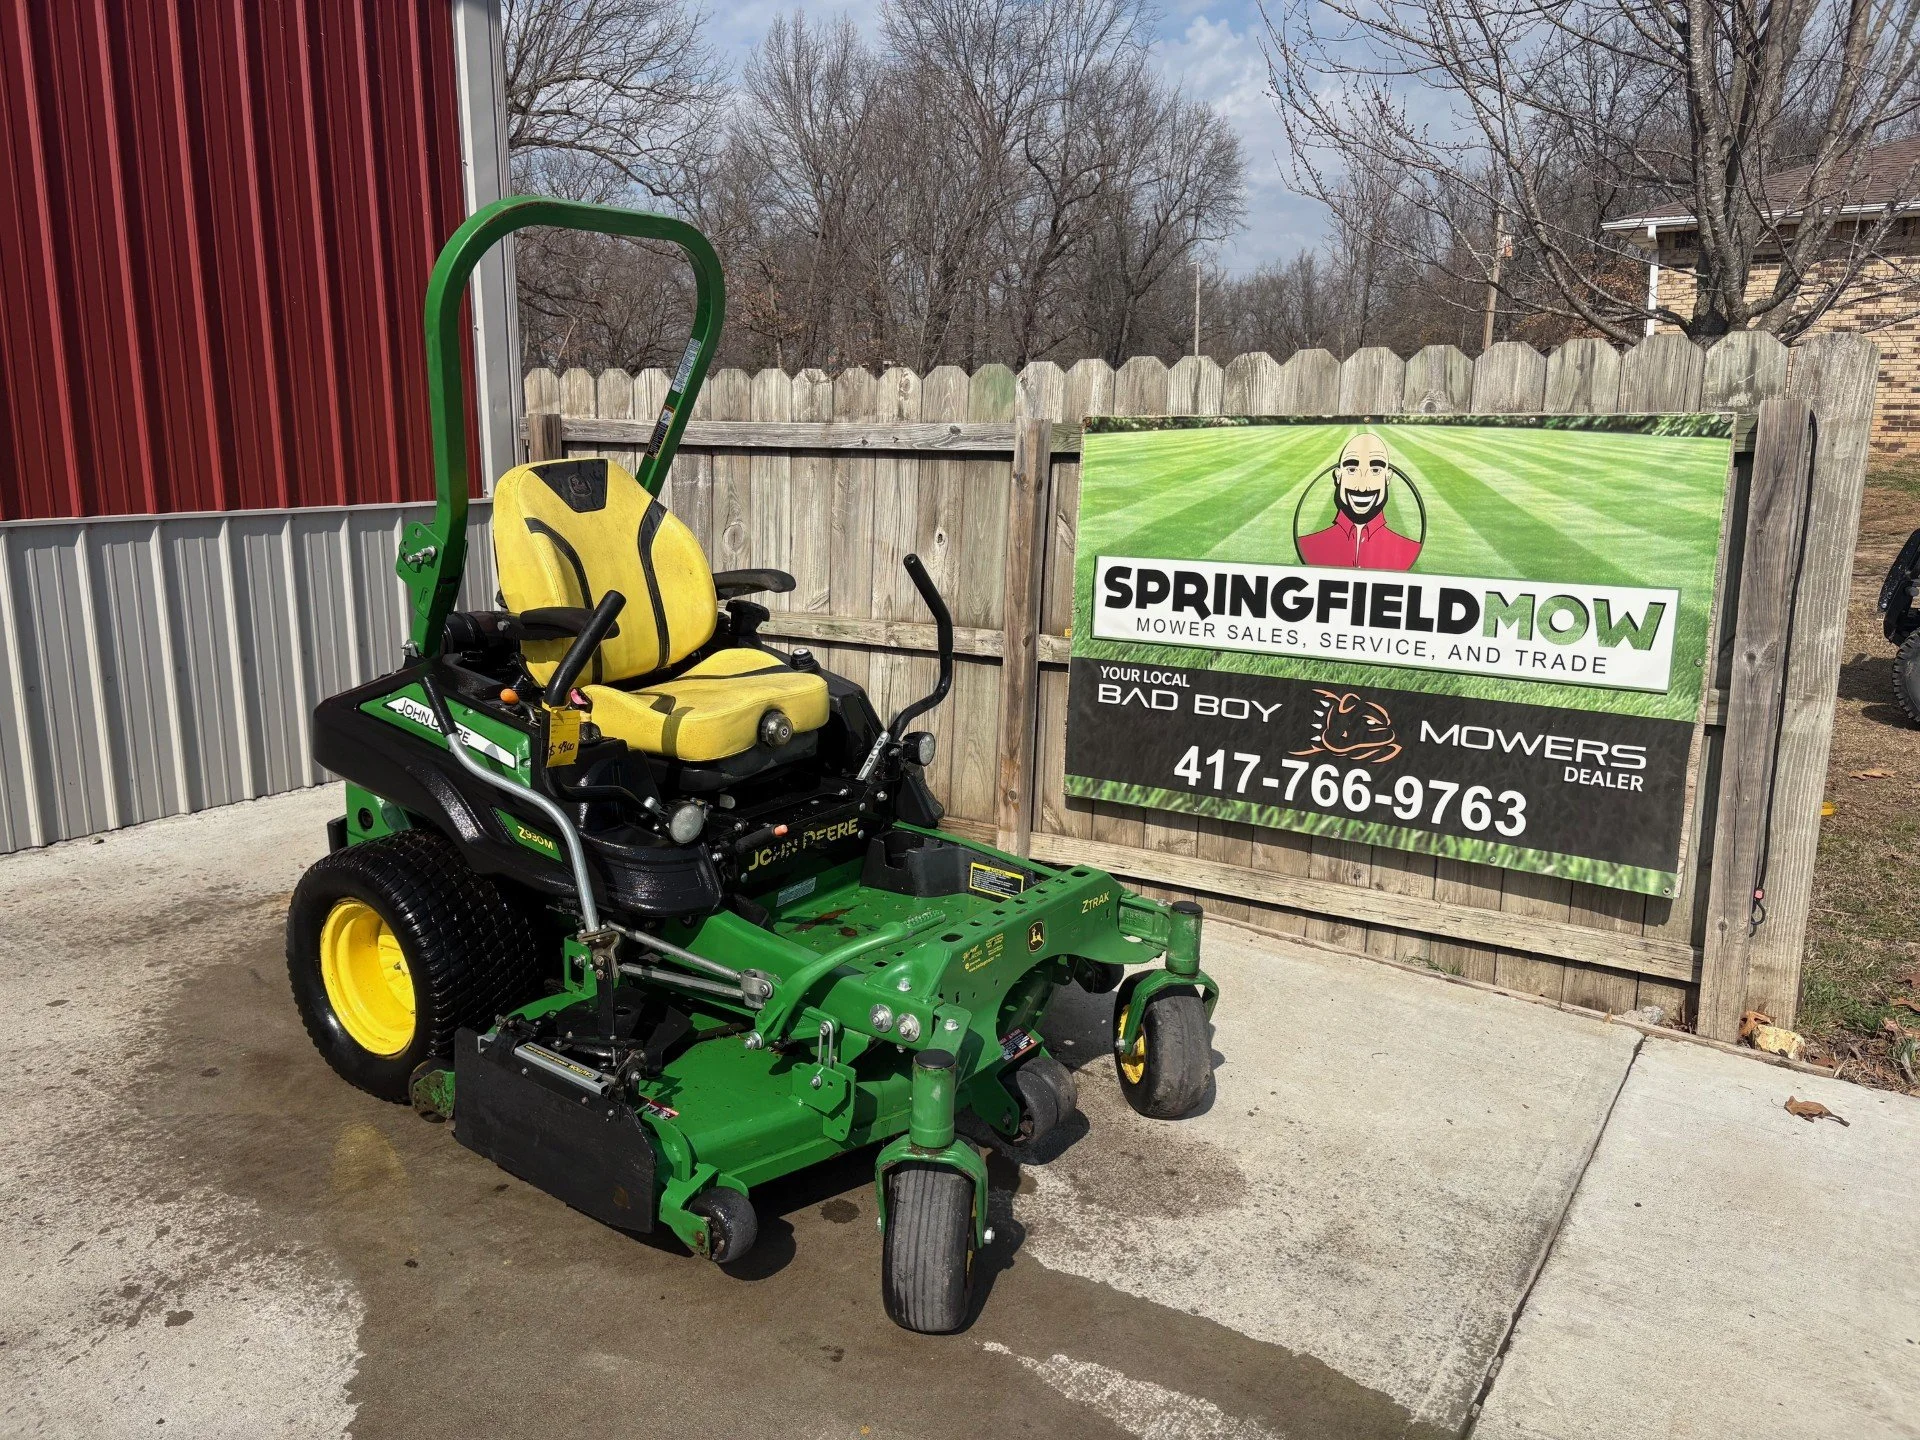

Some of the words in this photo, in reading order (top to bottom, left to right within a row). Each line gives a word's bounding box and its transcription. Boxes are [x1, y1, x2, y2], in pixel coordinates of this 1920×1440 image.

[1136, 616, 1216, 638] MOWER
[1227, 623, 1308, 649] SALES,
[1319, 632, 1436, 661] SERVICE,
[1447, 643, 1502, 664] AND
[1515, 649, 1608, 675] TRADE
[1100, 665, 1141, 683] YOUR
[1142, 670, 1191, 688] LOCAL
[398, 700, 431, 724] JOHN
[1097, 683, 1179, 711] BAD
[1193, 693, 1283, 723] BOY
[1419, 719, 1648, 770] MOWERS
[1173, 745, 1528, 837] 417-766-9763
[1563, 766, 1645, 792] DEALER
[517, 825, 554, 850] Z930M
